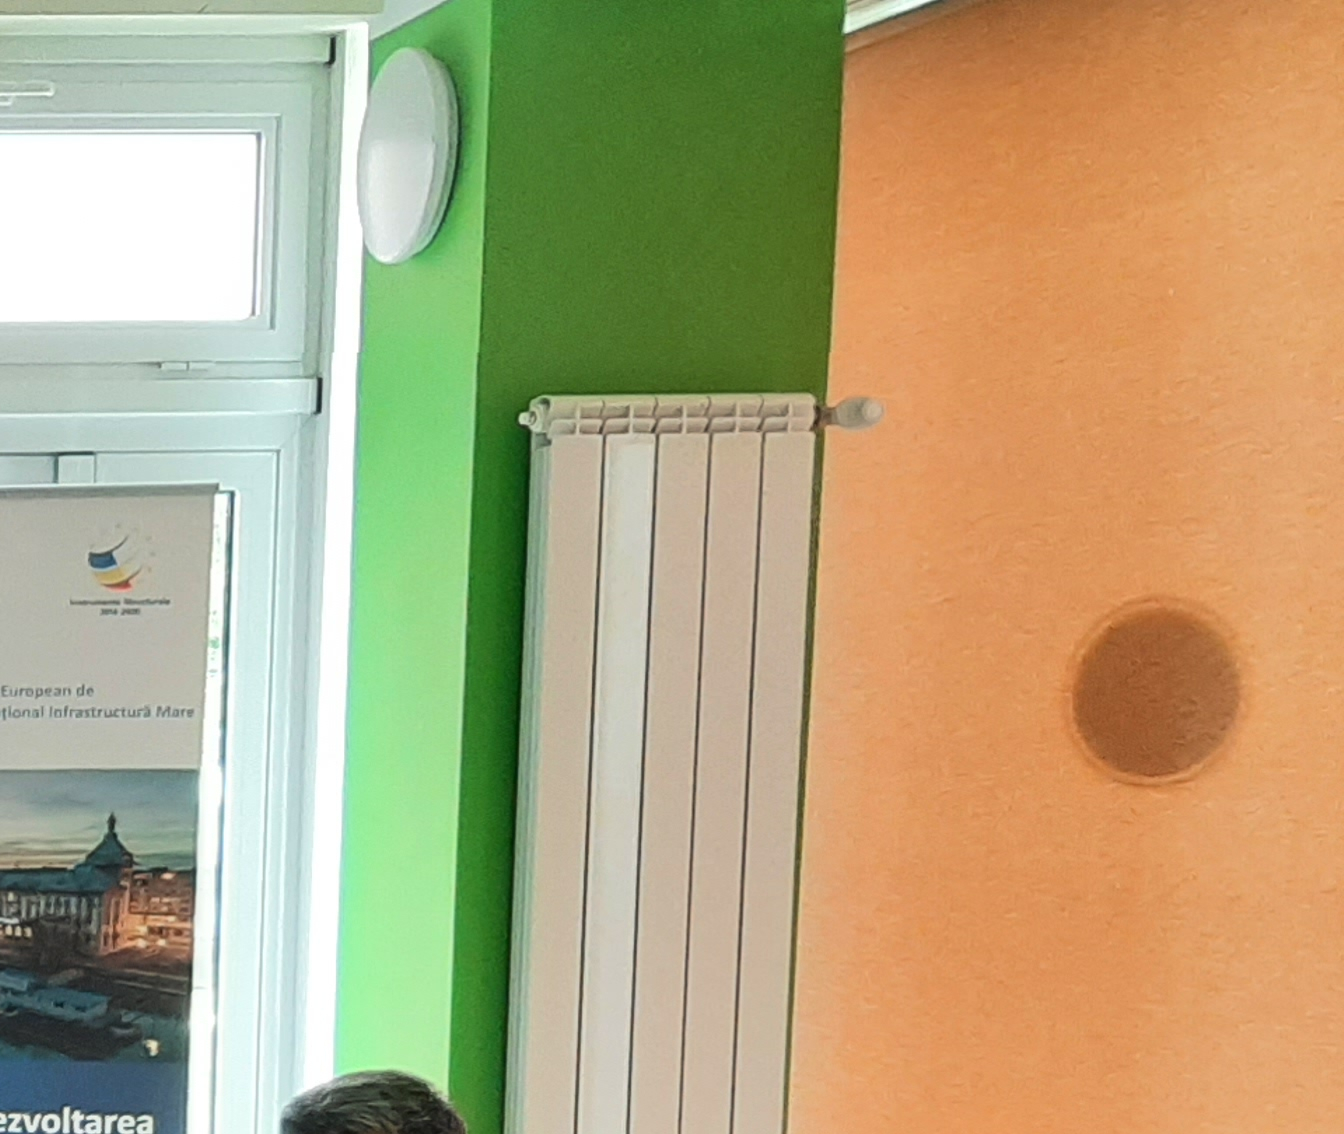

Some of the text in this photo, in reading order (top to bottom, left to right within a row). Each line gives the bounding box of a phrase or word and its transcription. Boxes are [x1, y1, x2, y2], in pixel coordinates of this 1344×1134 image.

[1, 685, 72, 700] European
[76, 684, 95, 698] de
[49, 705, 152, 719] Infrastructură
[156, 705, 196, 719] Mare
